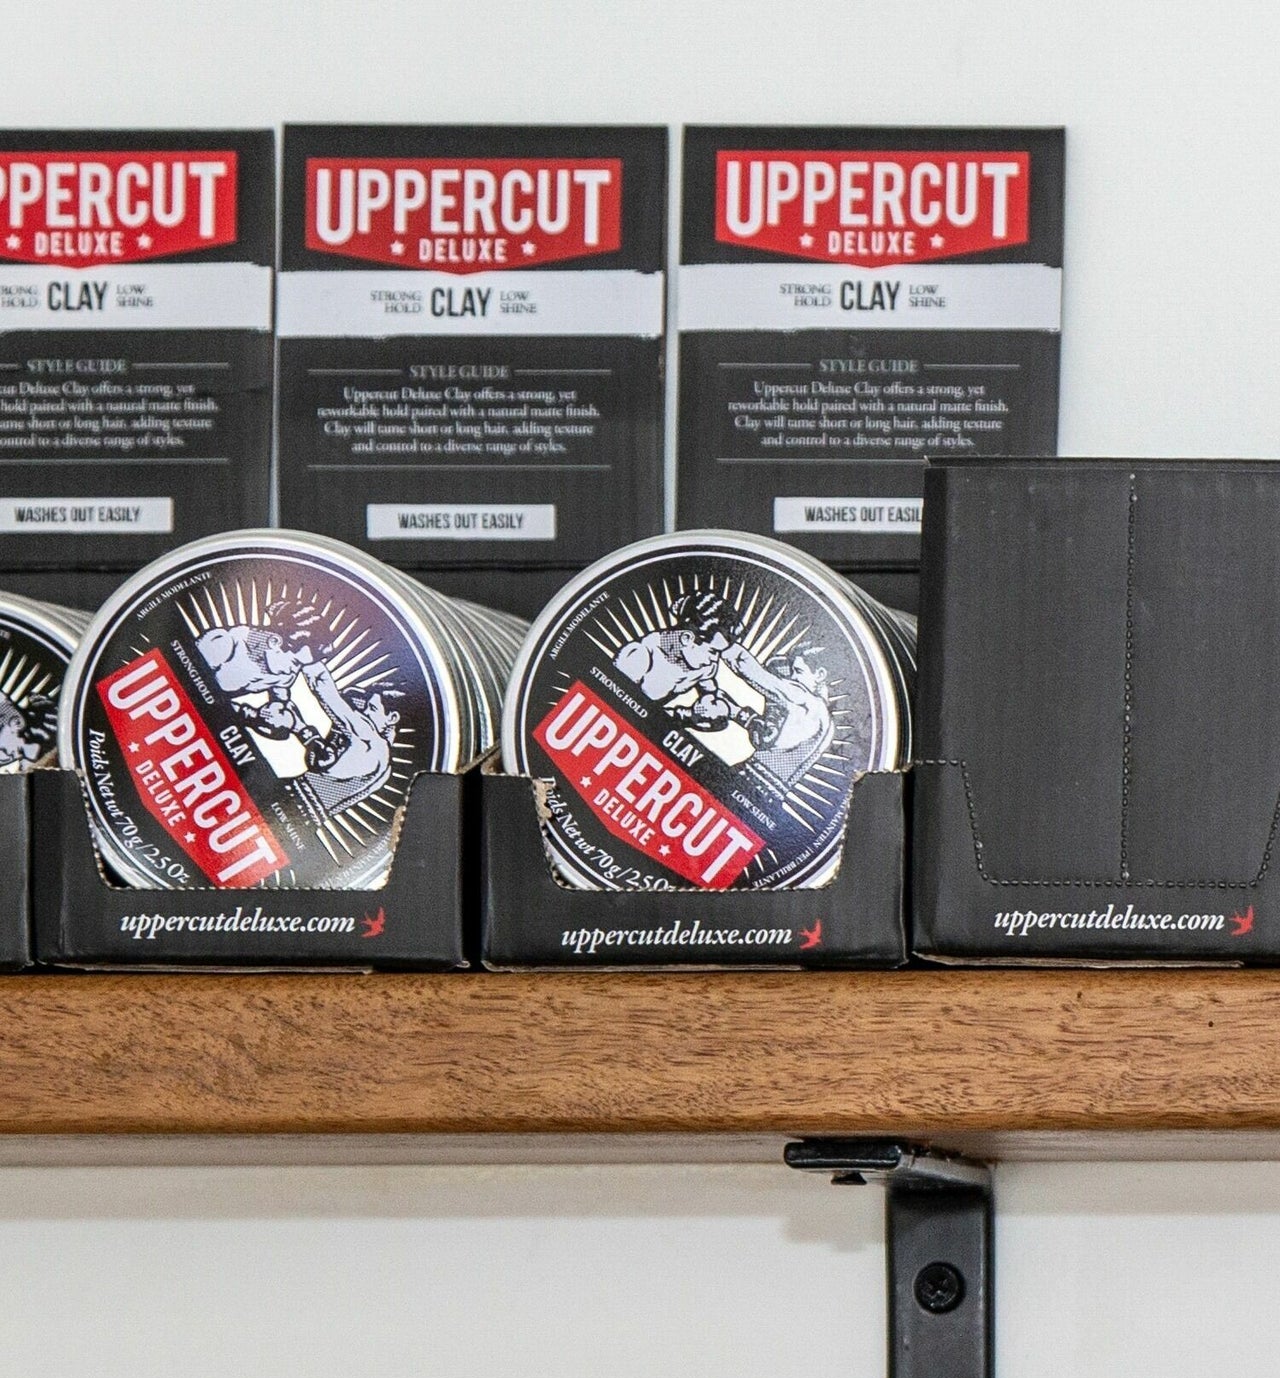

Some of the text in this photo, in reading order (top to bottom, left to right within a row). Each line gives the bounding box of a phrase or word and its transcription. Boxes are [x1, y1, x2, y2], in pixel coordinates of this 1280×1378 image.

[0, 161, 227, 239] PERCUT
[316, 168, 612, 246] UPPERCUT
[724, 161, 1019, 240] UPPERCUT
[34, 232, 124, 257] DELUXE
[418, 238, 508, 263] DELUXE
[828, 231, 916, 256] DELUXE
[48, 282, 108, 311] CLAY
[430, 288, 491, 318] CLAY
[779, 284, 831, 295] STRONG
[794, 296, 831, 307] HOLD
[840, 281, 901, 311] CLAY
[909, 285, 938, 295] LOW
[909, 297, 946, 307] SHINE
[820, 360, 918, 373] STYLE GUIDE
[754, 382, 808, 396] Uppercut
[811, 382, 851, 394] Deluxe
[854, 382, 880, 396] Clay
[884, 382, 915, 394] offers
[918, 386, 923, 394] a
[968, 384, 985, 397] yet
[728, 399, 790, 412] reworkable
[792, 399, 818, 411] hold
[822, 400, 856, 414] paired
[860, 399, 884, 412] with
[888, 404, 894, 412] a
[898, 400, 936, 412] natural
[940, 402, 972, 412] matte
[734, 416, 760, 431] Clay
[764, 416, 784, 428] will
[788, 418, 815, 428] tame
[818, 416, 847, 428] short
[850, 420, 862, 428] or
[866, 416, 890, 431] long
[922, 416, 960, 432] adding
[964, 418, 1002, 429] texture
[761, 434, 782, 446] and
[786, 434, 826, 446] control
[829, 436, 840, 446] to
[844, 438, 850, 446] a
[853, 434, 891, 446] diverse
[894, 437, 924, 450] range
[928, 434, 942, 446] of
[15, 507, 141, 522] WASHES OUT EASILY
[398, 513, 523, 529] WASHES OUT EASILY
[805, 507, 922, 522] WASHES OUT EASIL
[220, 725, 256, 765] CLAY
[662, 730, 703, 767] CLAY
[107, 659, 282, 884] UPPERCUT
[135, 759, 185, 827] DELUXE
[545, 694, 752, 883] UPPERCUT
[594, 789, 655, 847] DELUXE
[731, 790, 776, 831] LOW SHINE
[120, 909, 355, 941] uppercutdeluxe.com
[561, 921, 792, 954] uppercutdeluxe.com
[992, 906, 1226, 942] uppercutdeluxe.com
